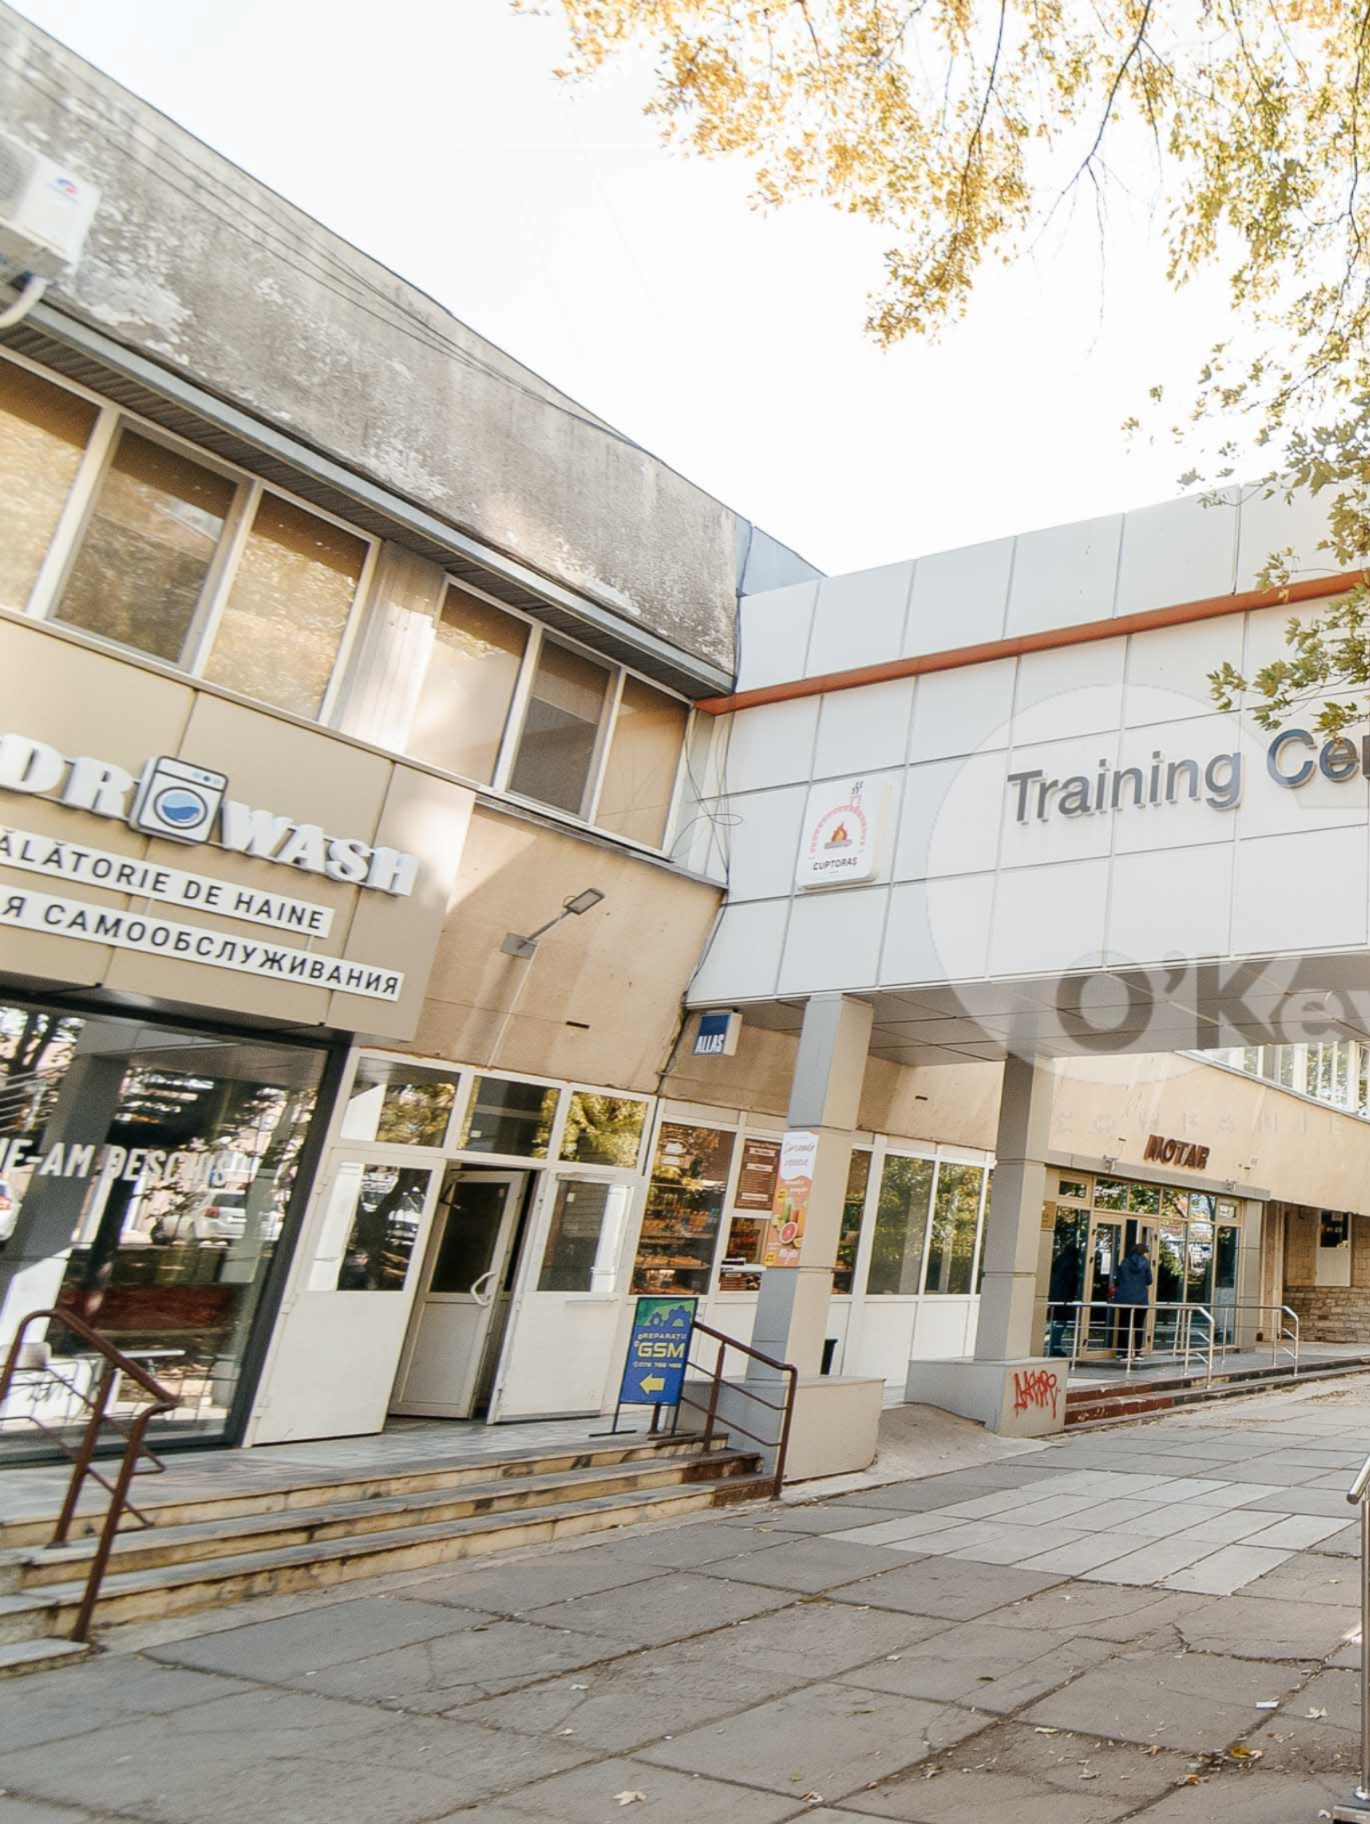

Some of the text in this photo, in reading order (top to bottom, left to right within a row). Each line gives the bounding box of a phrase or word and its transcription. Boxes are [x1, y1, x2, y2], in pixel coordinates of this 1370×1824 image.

[1007, 751, 1244, 825] Training
[221, 801, 418, 896] WASH
[183, 881, 219, 908] DE
[234, 892, 325, 930] HAINE
[44, 904, 399, 996] САМООБСЛУЖИВАНИЯ
[695, 1034, 725, 1053] ALLAS
[1144, 1134, 1210, 1170] NOTAR
[637, 1342, 685, 1358] GSM
